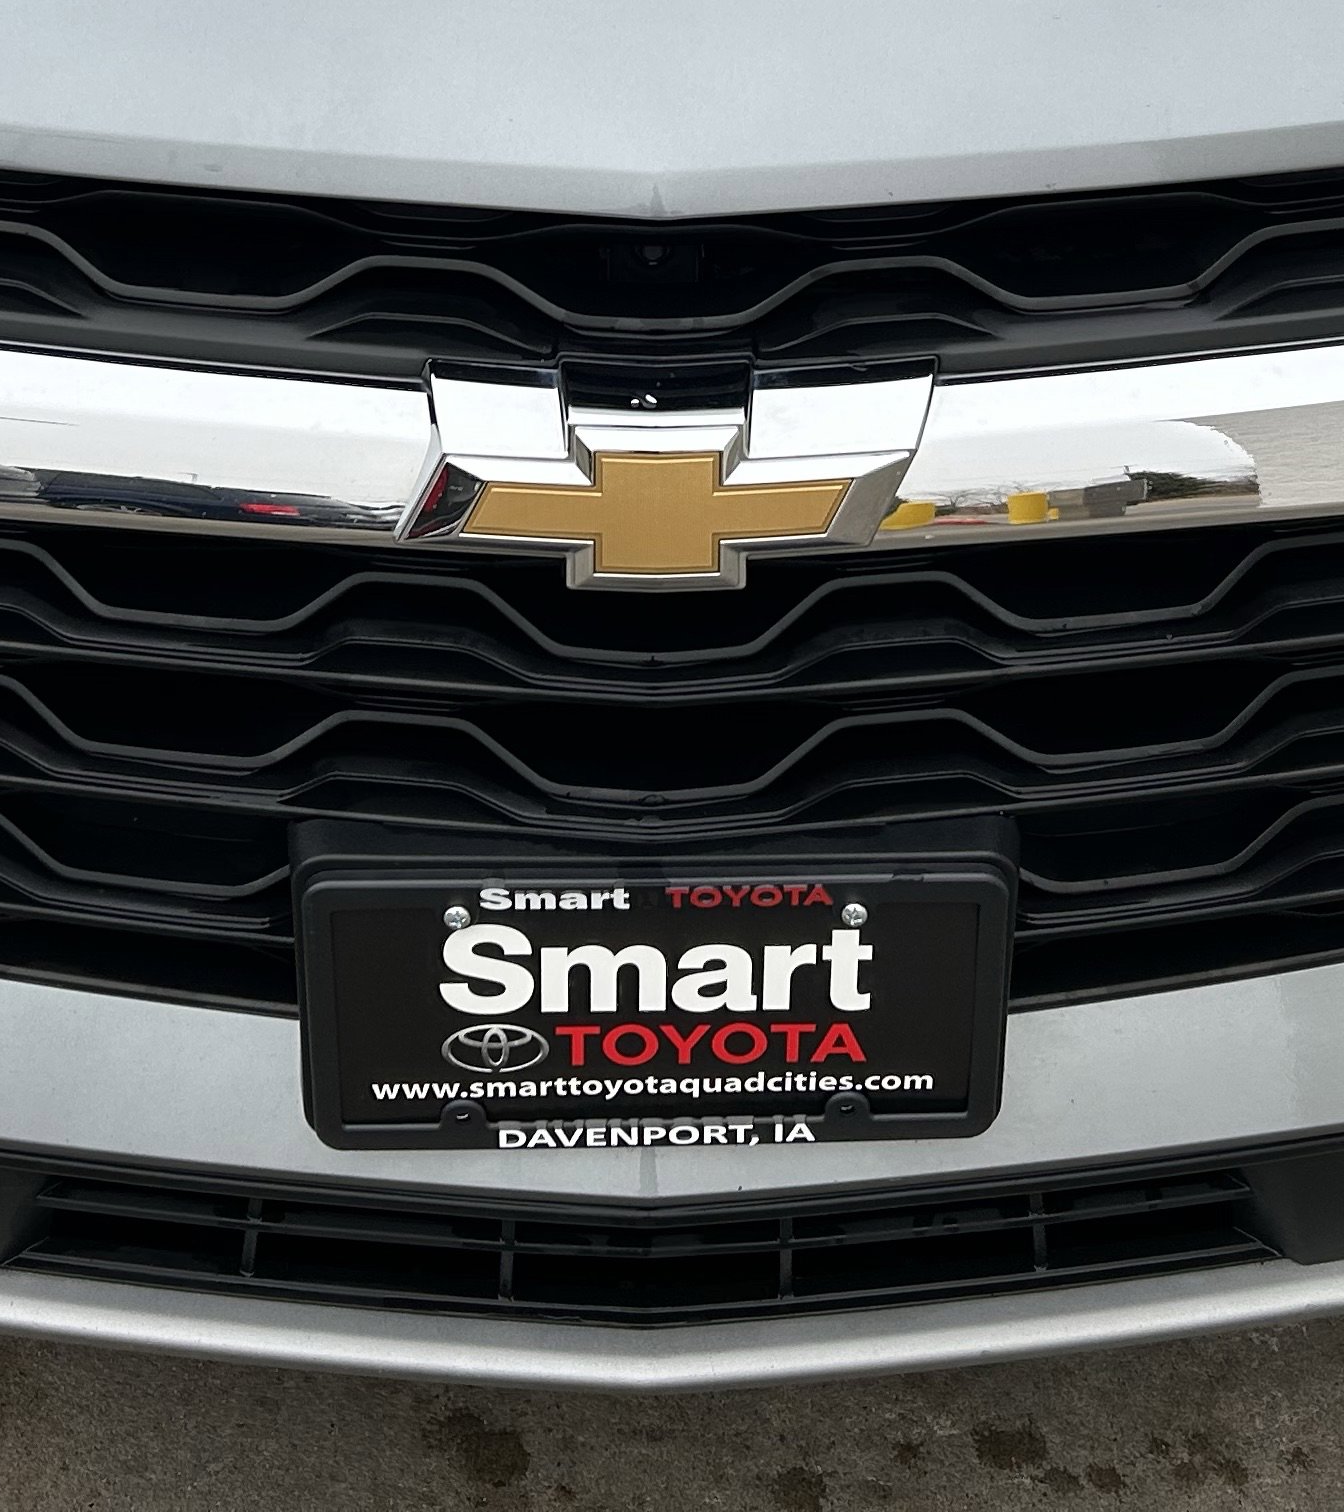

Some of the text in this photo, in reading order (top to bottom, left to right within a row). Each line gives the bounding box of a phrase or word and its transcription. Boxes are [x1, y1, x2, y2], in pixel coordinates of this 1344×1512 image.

[480, 885, 833, 910] Smart TOYOTA
[439, 924, 873, 1015] Smart
[555, 1022, 866, 1066] TOYOTA
[372, 1070, 934, 1100] www.smarttoyotaquadcities.com
[498, 1120, 816, 1149] DAVENPORT, IA
